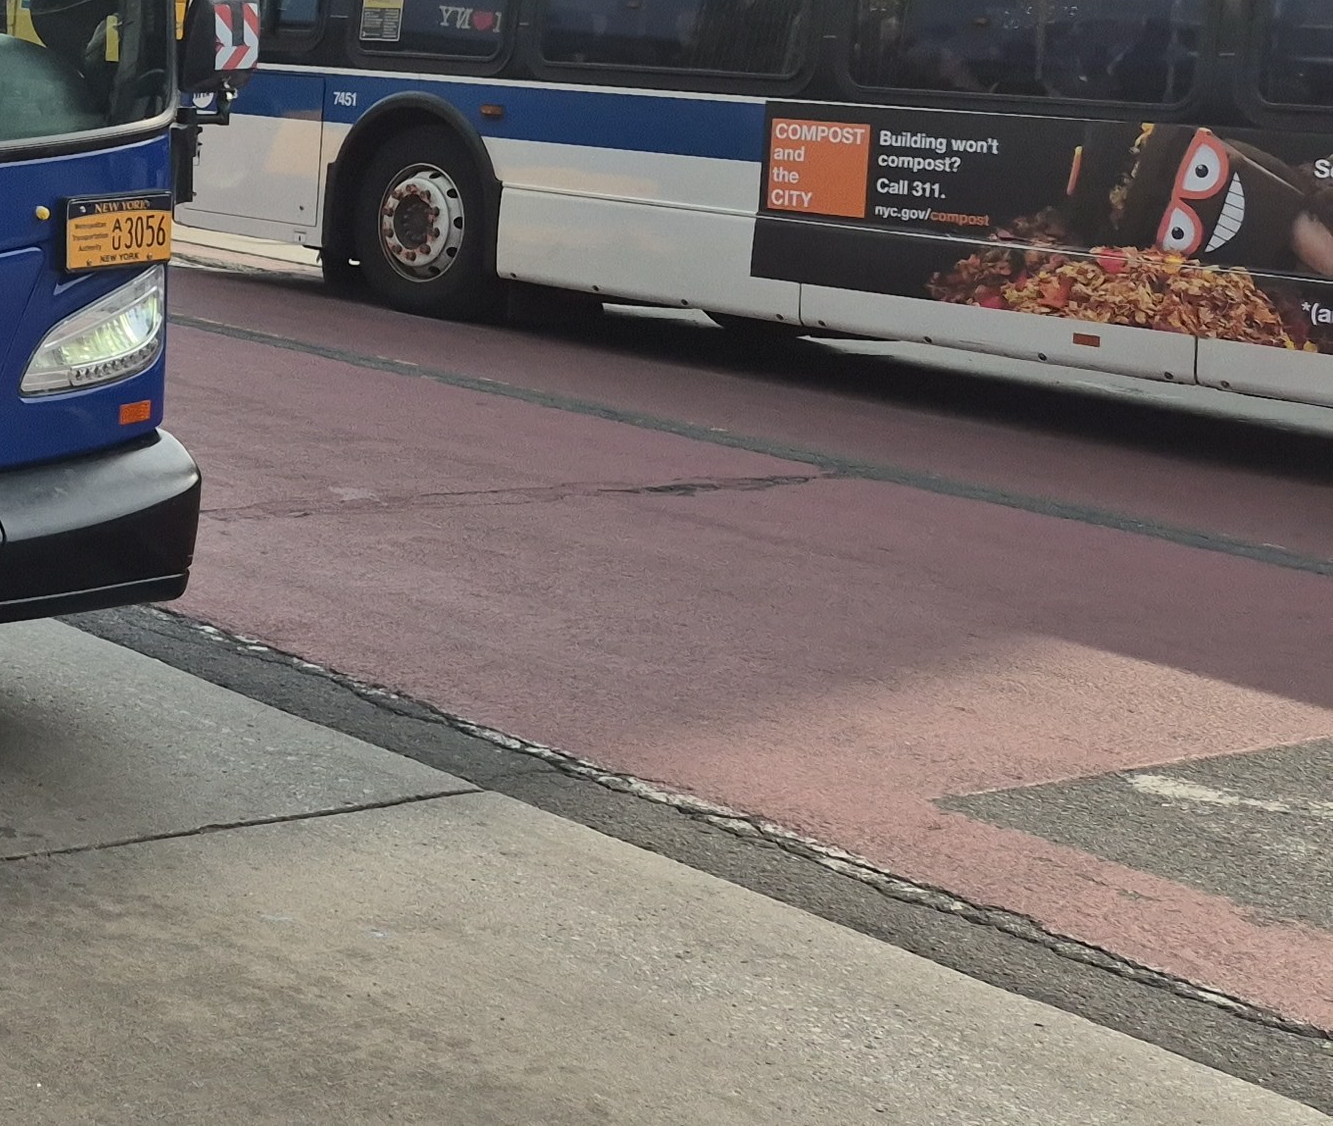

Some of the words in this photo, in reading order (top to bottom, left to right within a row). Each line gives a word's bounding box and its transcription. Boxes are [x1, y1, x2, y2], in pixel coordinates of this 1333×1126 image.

[334, 92, 357, 106] 7451
[775, 123, 866, 145] COMPOST
[879, 130, 947, 154] Building
[951, 137, 999, 155] won't
[774, 146, 805, 162] and
[878, 154, 961, 173] compost?
[772, 167, 800, 184] the
[771, 189, 813, 208] CITY
[876, 178, 908, 196] Call
[912, 182, 946, 200] 311.
[95, 202, 118, 214] NEW
[122, 200, 146, 210] YORK
[874, 204, 990, 226] nyc.gov/compost
[125, 214, 166, 249] 3056
[100, 254, 118, 262] NEW
[119, 252, 140, 261] YORK
